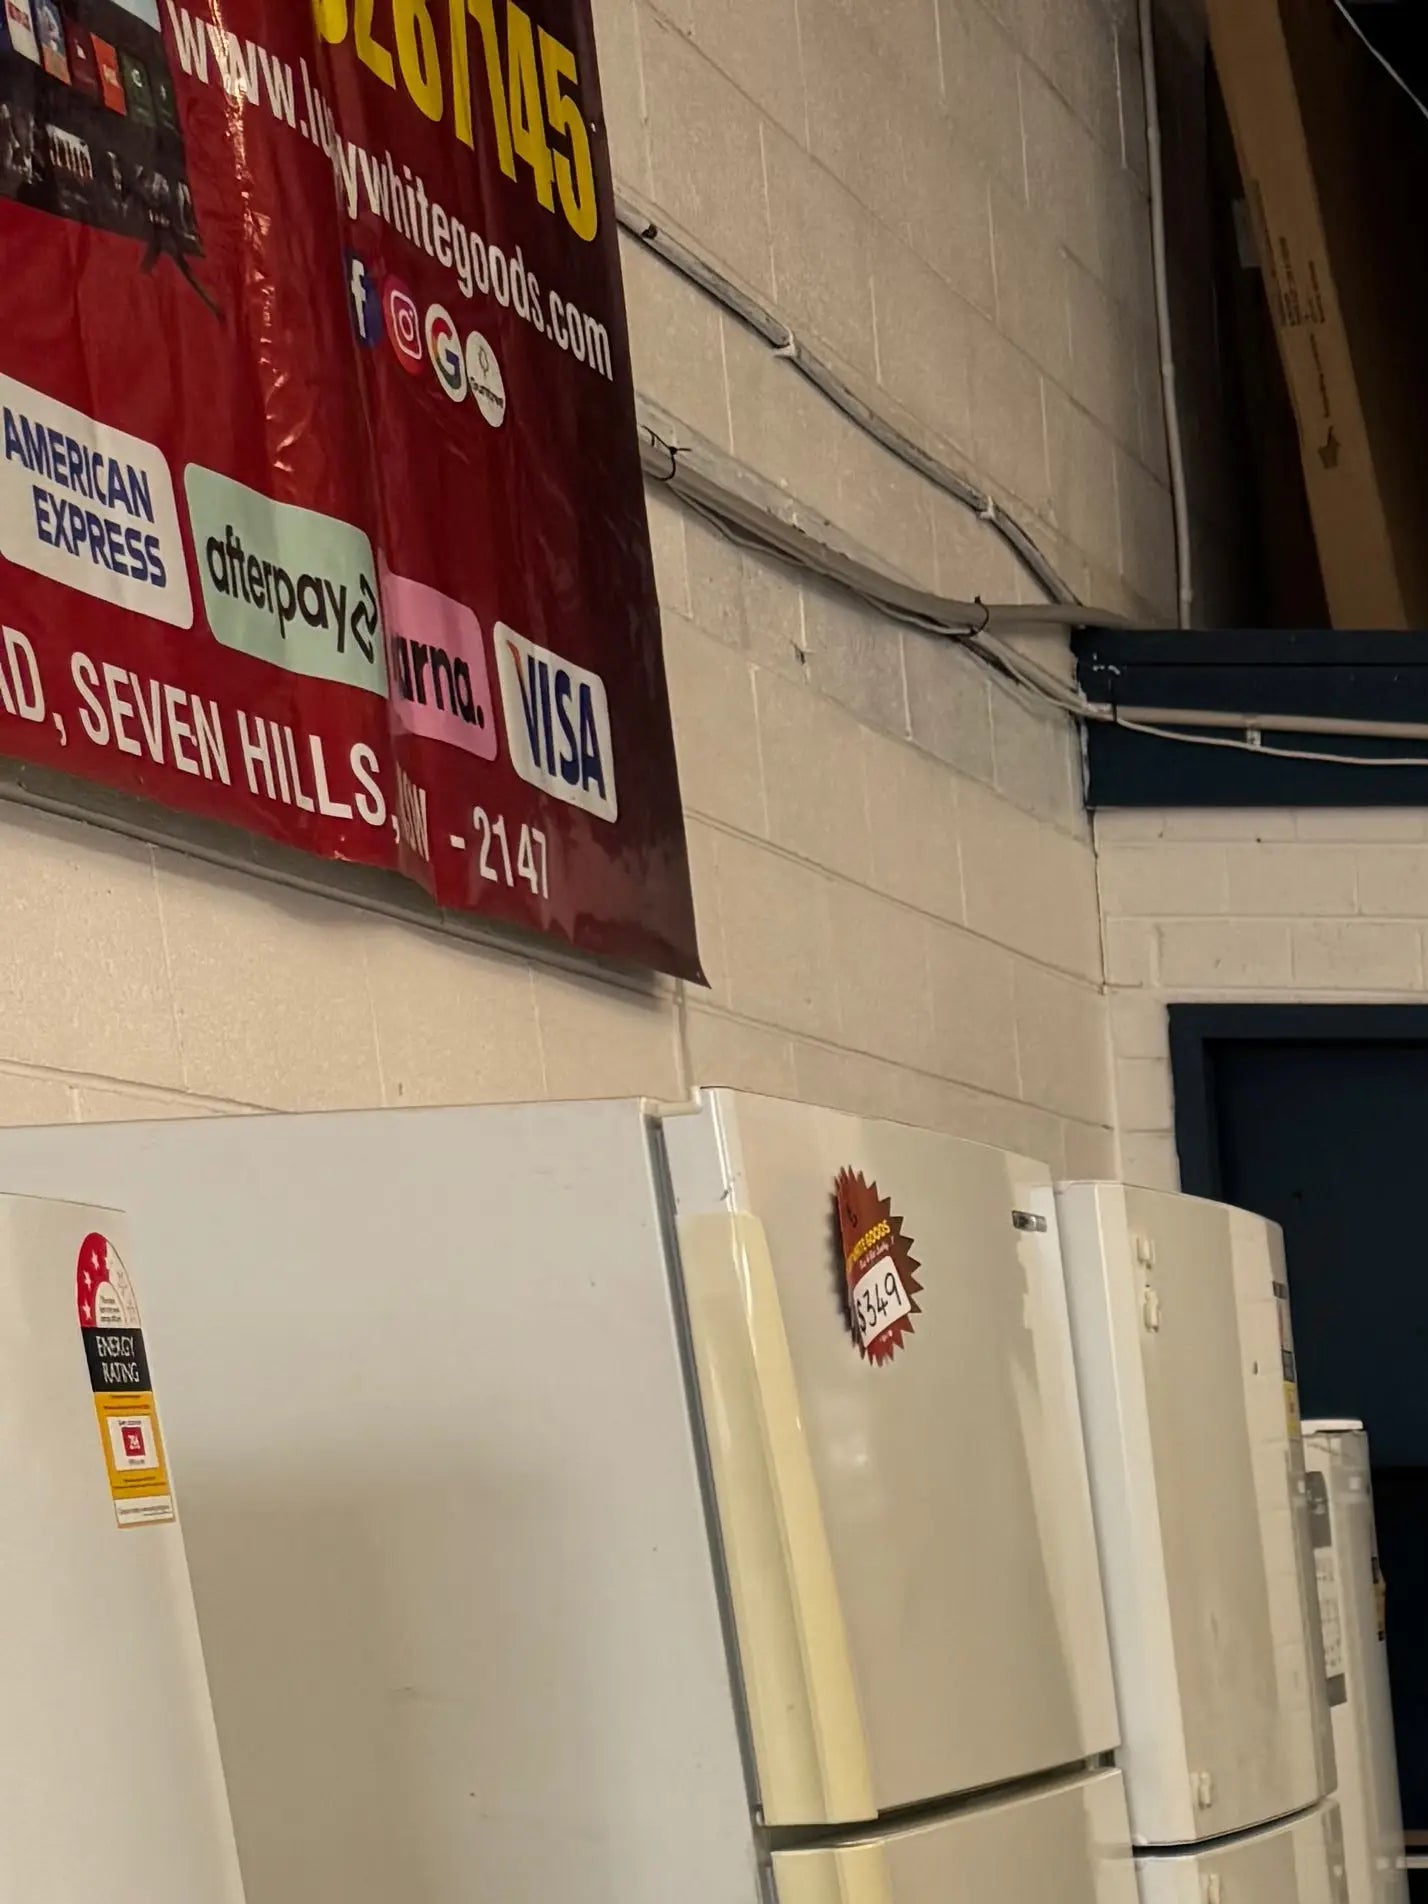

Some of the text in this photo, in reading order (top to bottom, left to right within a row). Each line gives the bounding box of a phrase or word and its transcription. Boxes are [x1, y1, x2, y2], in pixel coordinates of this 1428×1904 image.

[3, 407, 155, 523] AMERICAN
[33, 486, 167, 588] EXPRESS
[206, 525, 347, 653] afterpay
[71, 651, 230, 786] SEVEN
[473, 806, 548, 899] 2147
[507, 640, 607, 800] VISA
[96, 1336, 135, 1357] ENERGY
[856, 1272, 902, 1336] $349
